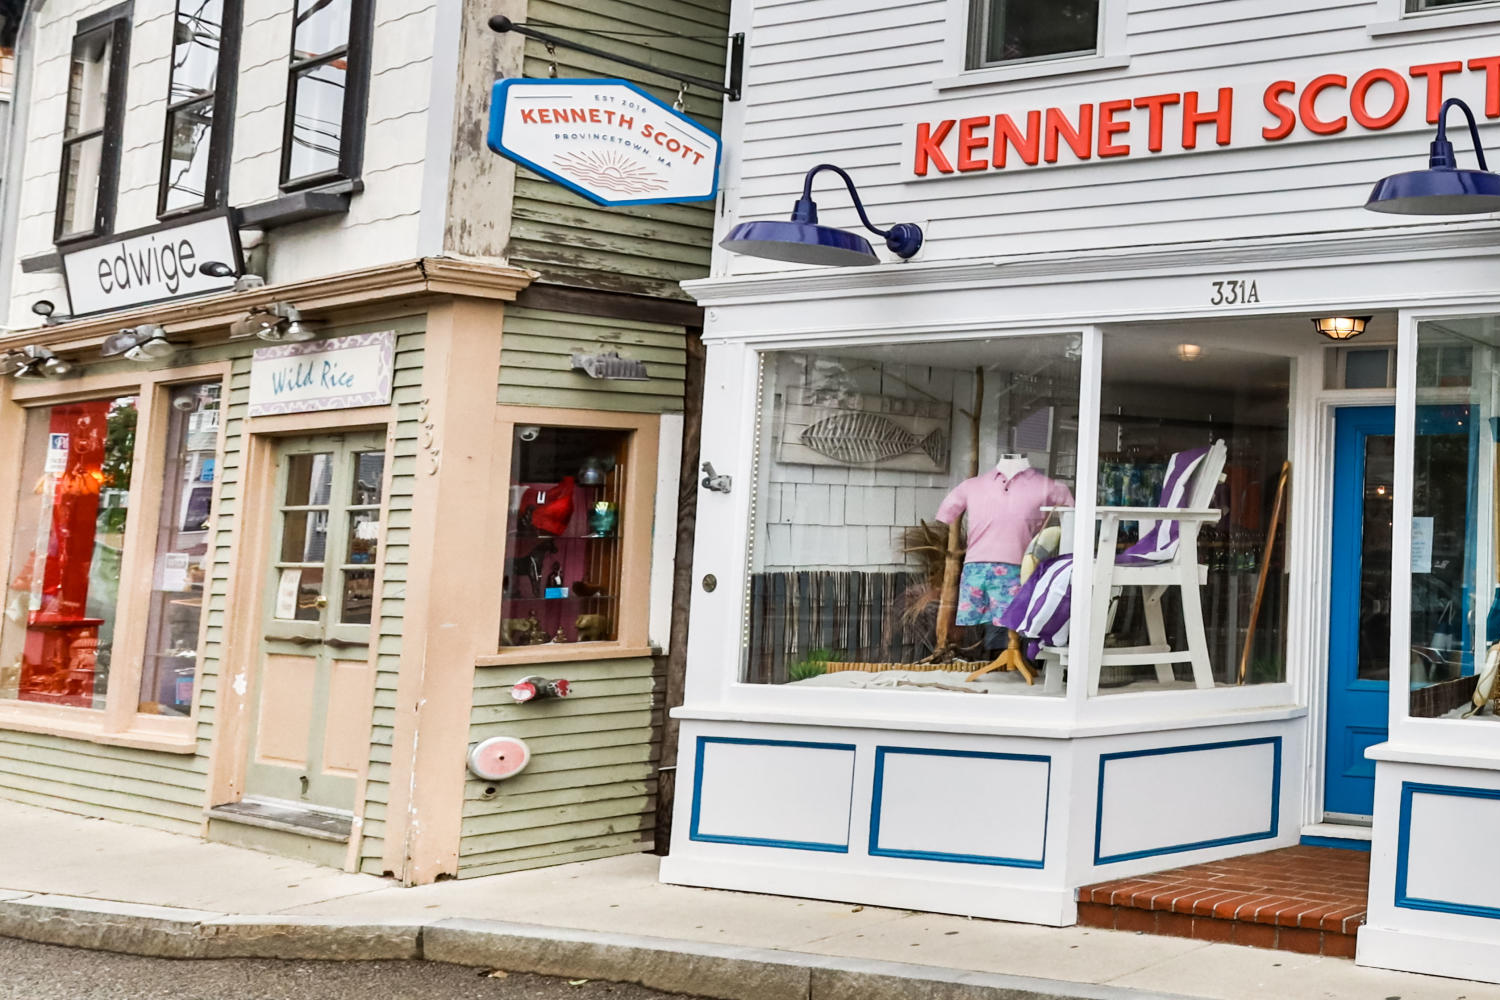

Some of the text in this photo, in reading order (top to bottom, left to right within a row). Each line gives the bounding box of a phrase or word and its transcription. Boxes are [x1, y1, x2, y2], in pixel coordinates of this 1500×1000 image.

[621, 99, 647, 113] 2016
[520, 108, 704, 166] KENNETH SCOTT
[913, 87, 1233, 176] KENNETH
[657, 157, 672, 168] MA
[98, 236, 196, 294] edwige
[1210, 280, 1260, 305] 331A
[272, 360, 355, 395] Wild Rice
